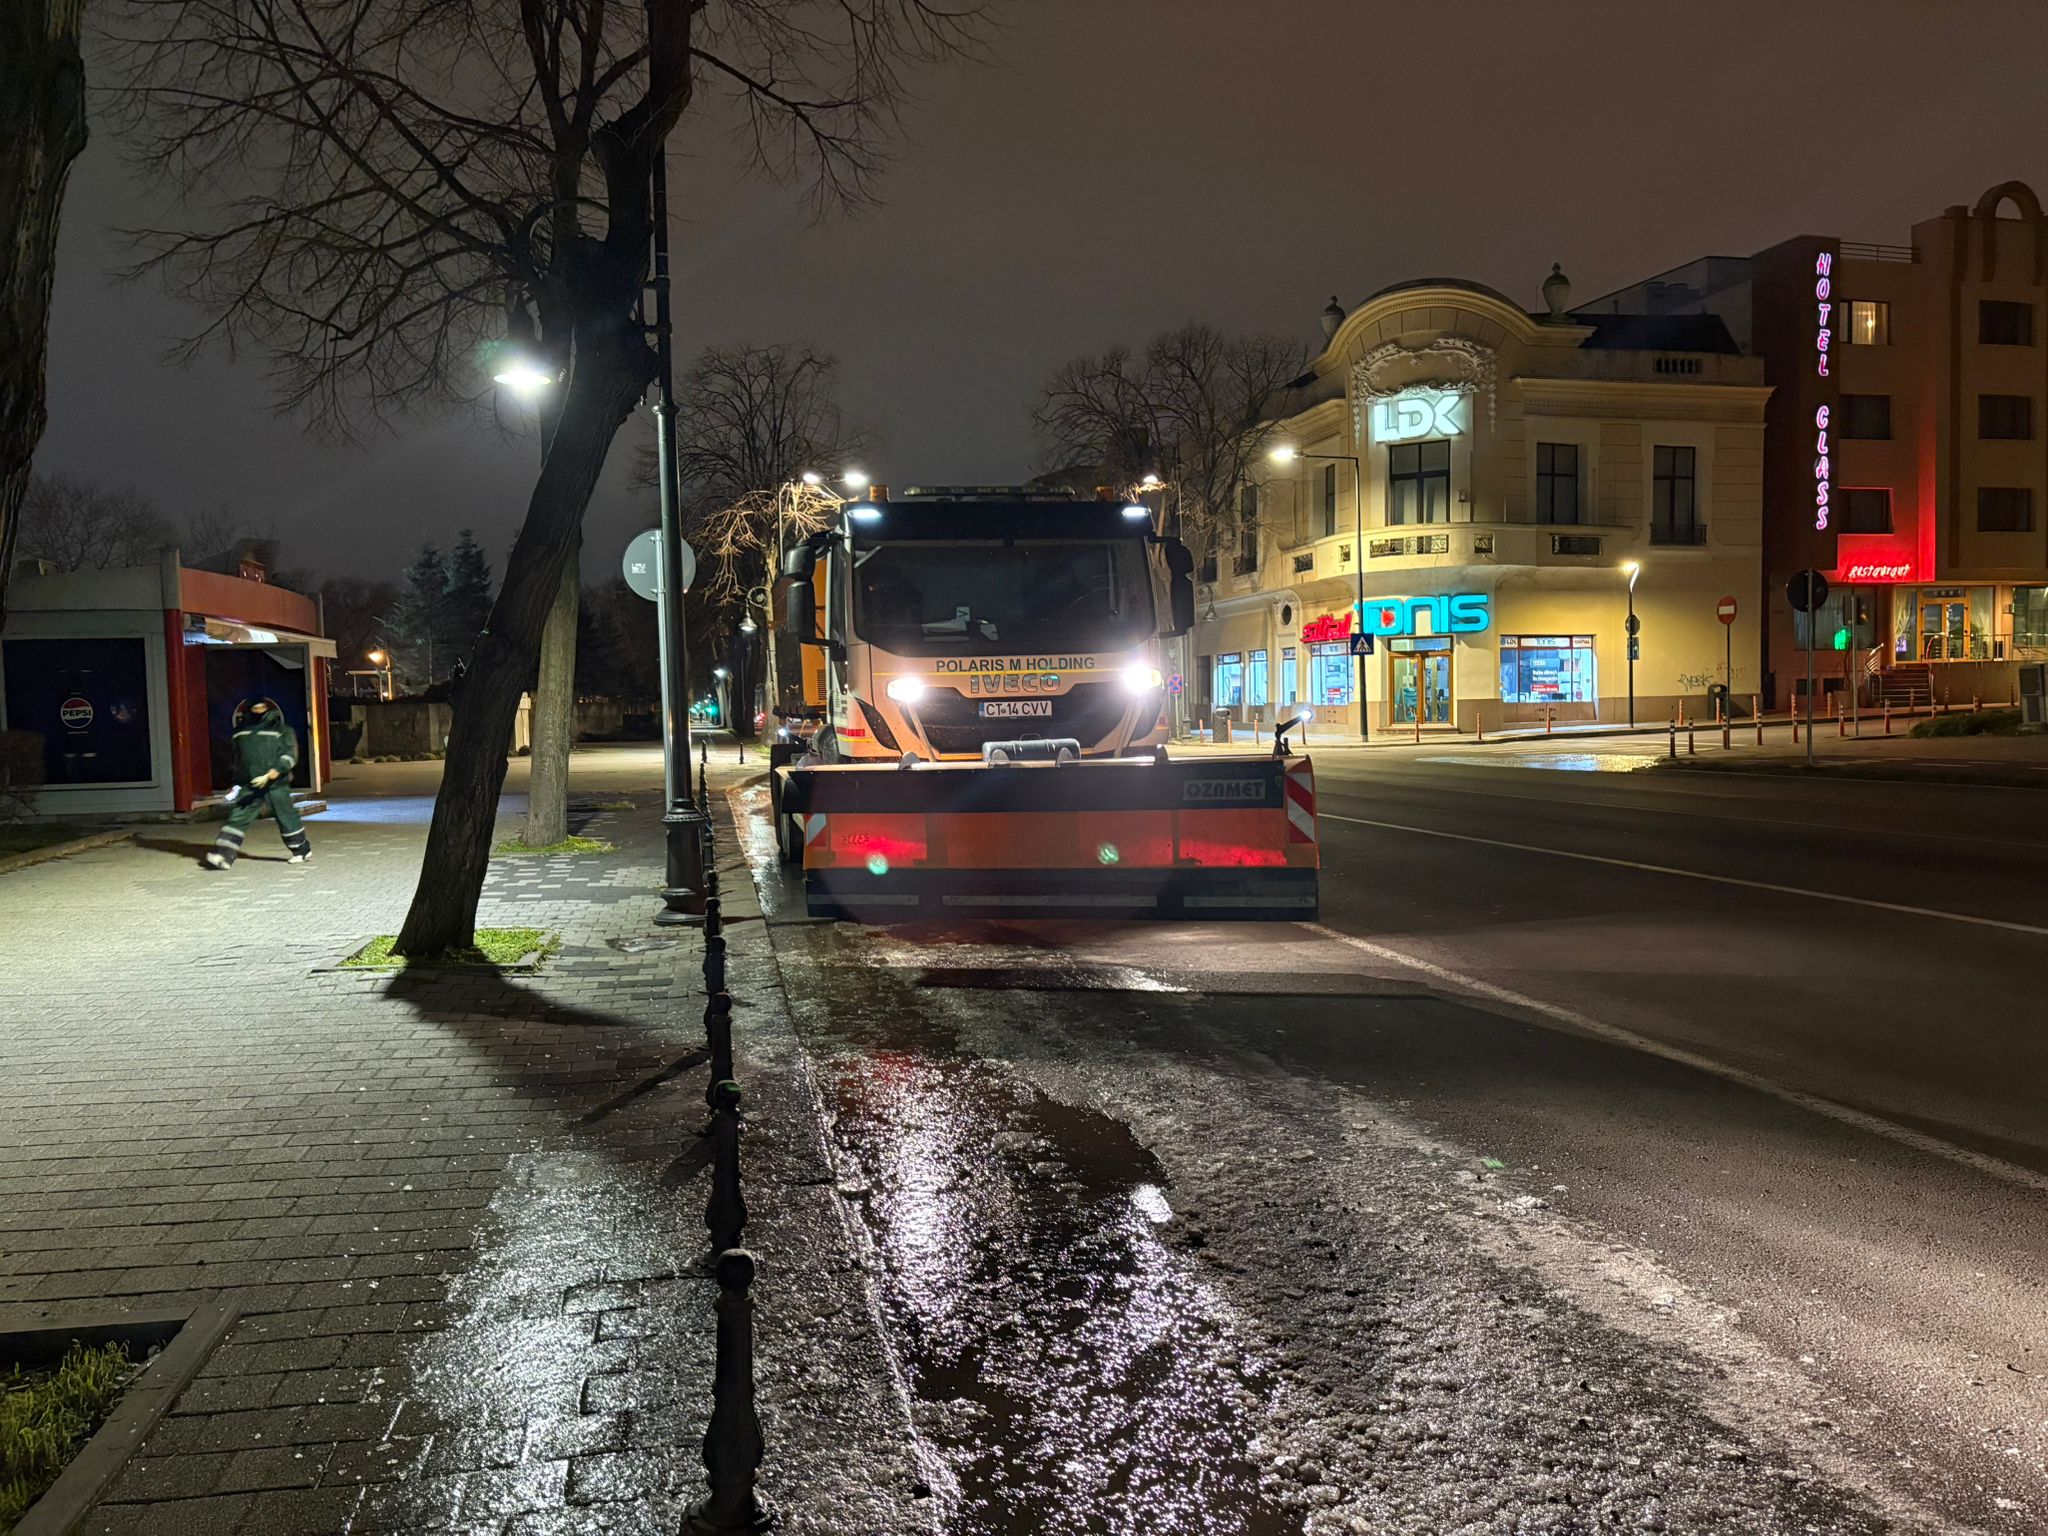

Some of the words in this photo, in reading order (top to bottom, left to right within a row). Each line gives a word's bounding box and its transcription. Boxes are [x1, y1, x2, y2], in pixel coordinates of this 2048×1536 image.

[1815, 252, 1832, 377] HOTEL
[1373, 394, 1465, 443] LDK
[1815, 404, 1830, 531] CLASS
[936, 659, 1005, 673] POLARIS
[1009, 658, 1022, 671] M
[1026, 656, 1095, 670] HOLDING
[970, 673, 1061, 694] IVECO
[62, 709, 91, 717] PEPSI
[986, 703, 1003, 716] CT
[1007, 702, 1019, 716] 14
[1021, 702, 1048, 715] CVV
[1186, 781, 1264, 798] OZAMET
